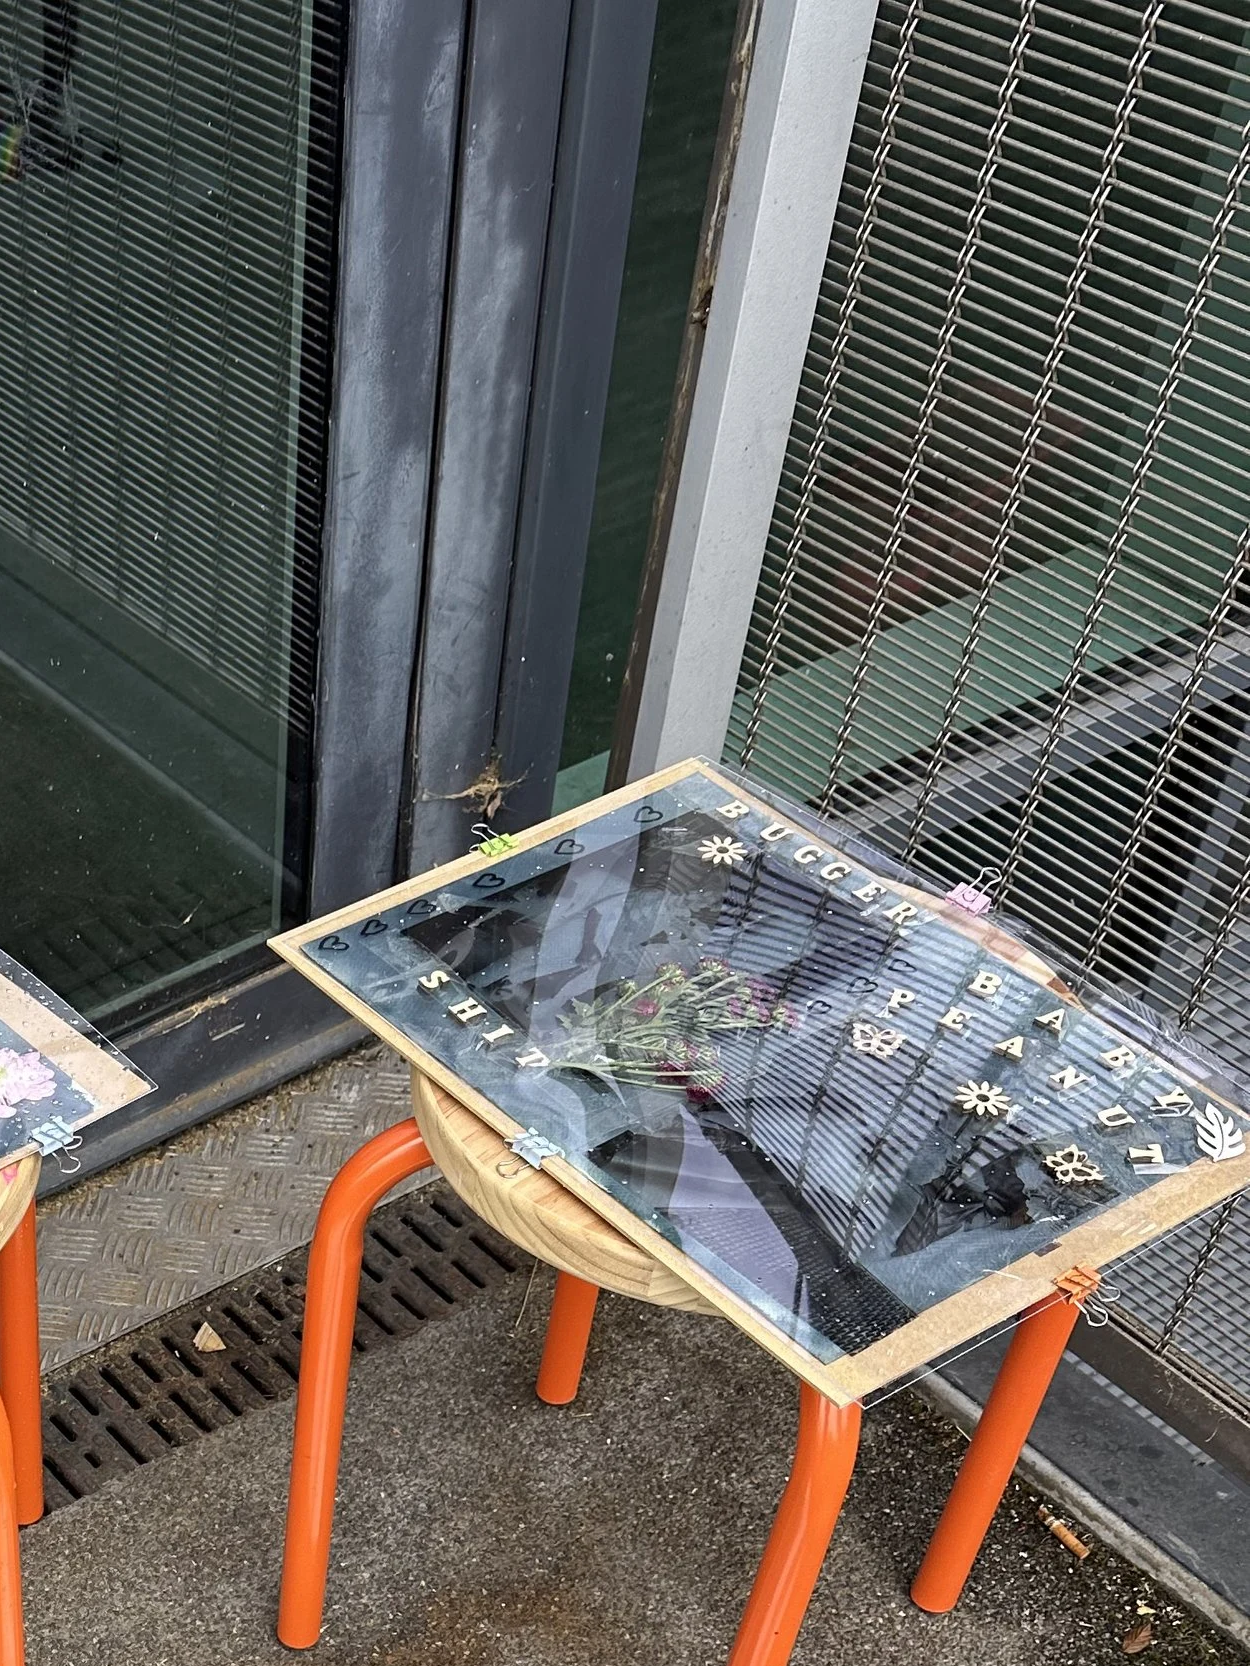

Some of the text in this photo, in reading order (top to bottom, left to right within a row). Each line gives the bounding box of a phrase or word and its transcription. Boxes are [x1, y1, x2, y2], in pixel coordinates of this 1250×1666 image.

[418, 971, 551, 1068] SHIT
[716, 800, 1193, 1114] BUGGER BABY
[890, 988, 1164, 1164] PEANUT
